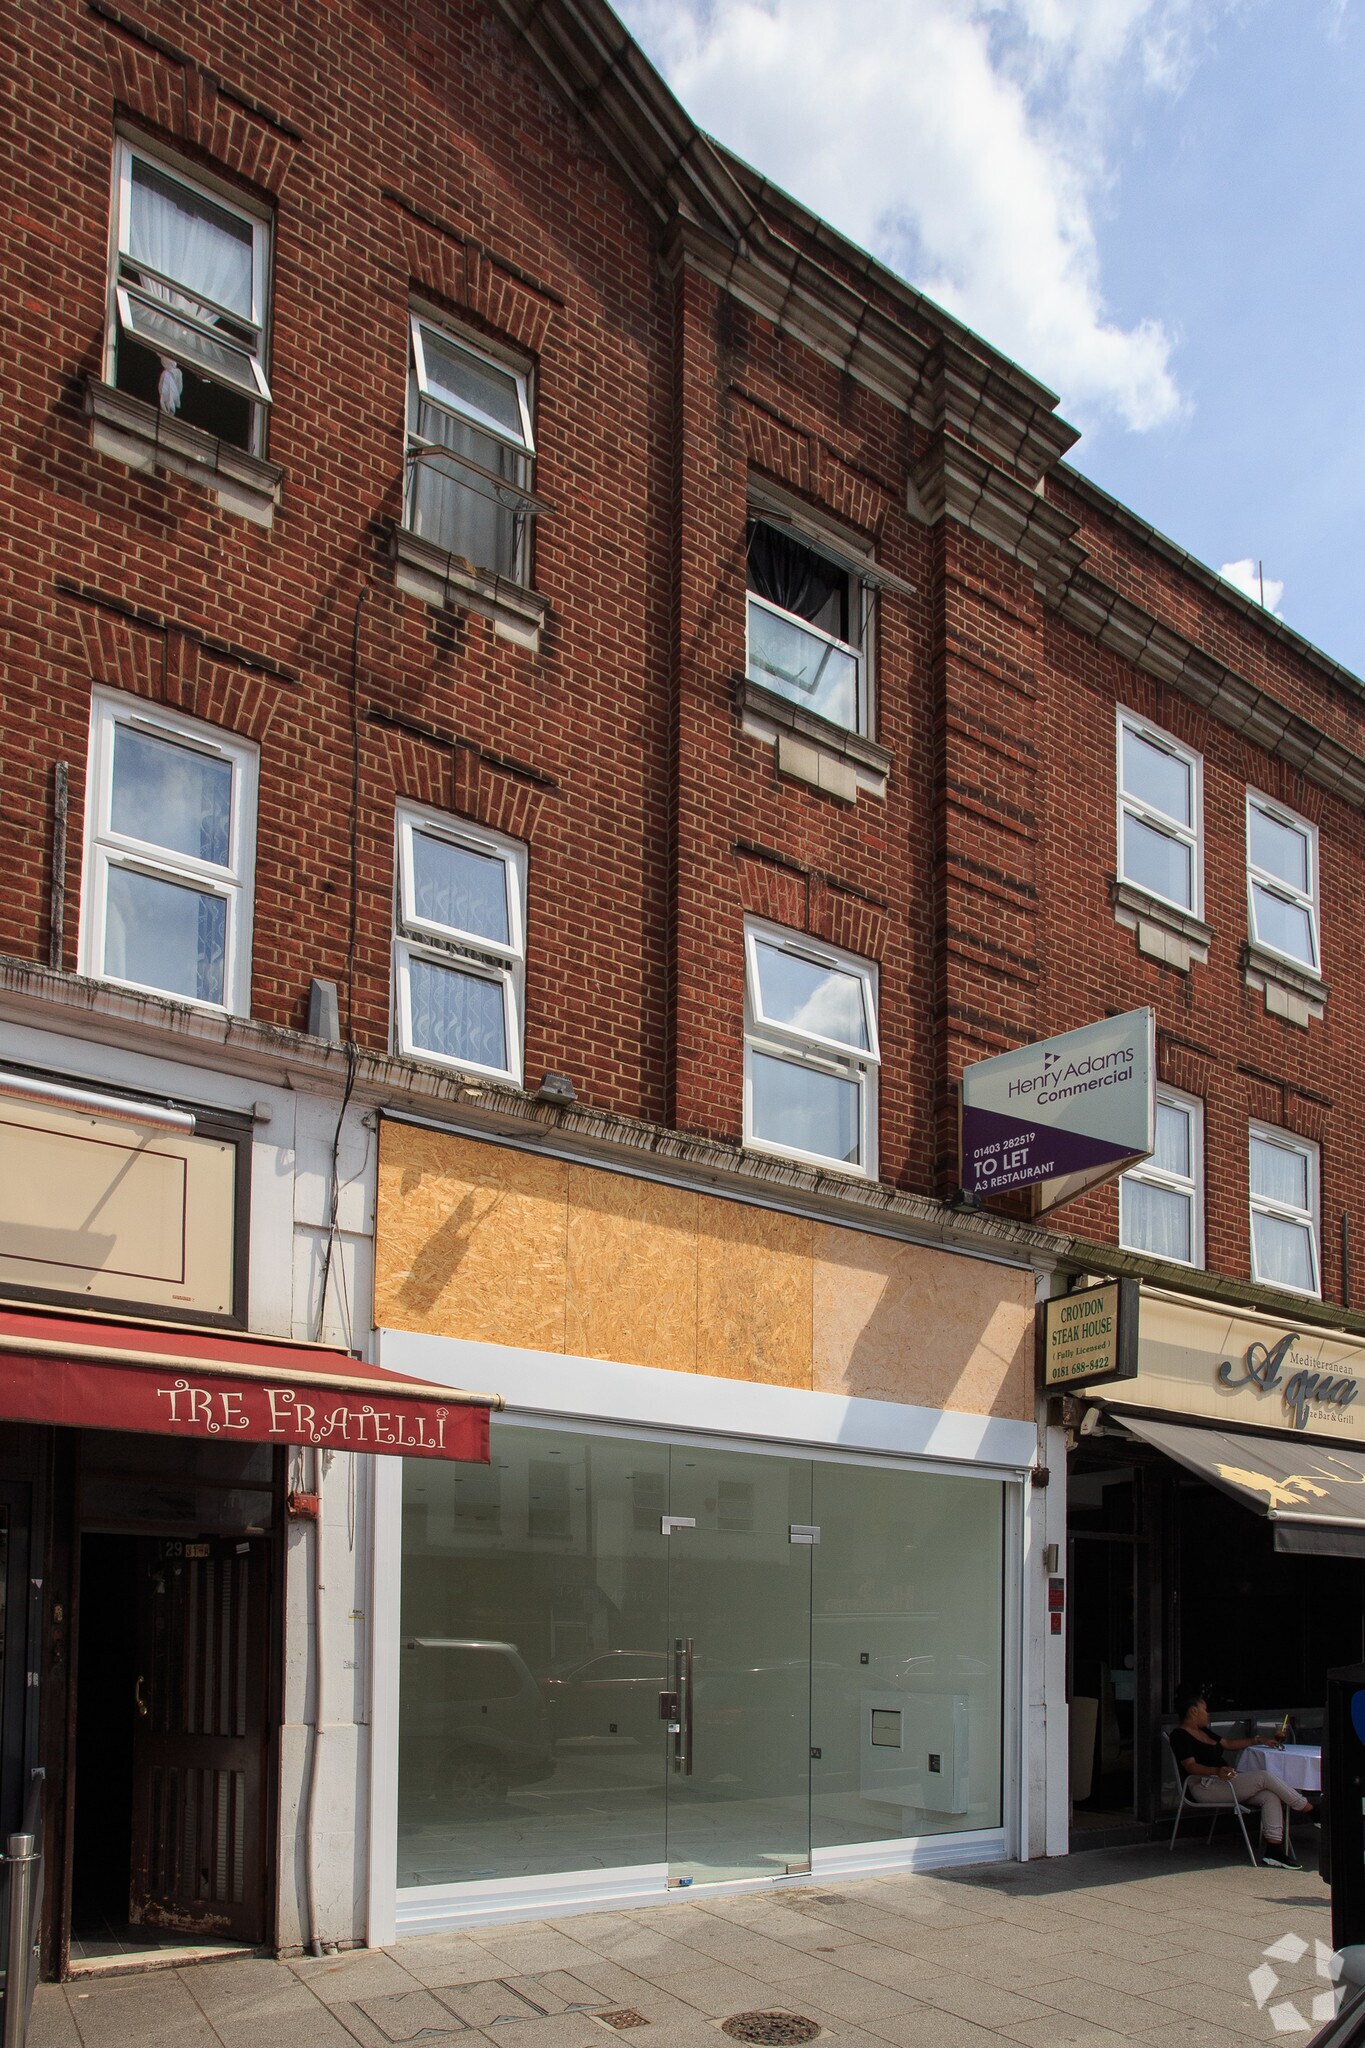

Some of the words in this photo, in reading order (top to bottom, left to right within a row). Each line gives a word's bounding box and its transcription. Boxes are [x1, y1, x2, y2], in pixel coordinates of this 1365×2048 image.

[1008, 1069, 1063, 1098] Henry
[1063, 1048, 1134, 1081] Adams
[1037, 1066, 1133, 1105] Commercial
[973, 1143, 1001, 1159] 01403
[1002, 1132, 1036, 1151] 282519
[974, 1158, 997, 1178] TO
[1003, 1148, 1029, 1171] LET
[974, 1179, 989, 1193] A3
[990, 1161, 1055, 1188] RESTAURANT
[1060, 1297, 1104, 1323] CROYDON
[1052, 1325, 1080, 1346] STEAK
[1081, 1316, 1112, 1339] HOUSE
[1052, 1366, 1069, 1379] 0181
[1071, 1356, 1109, 1375] 688-8422
[1290, 1352, 1353, 1375] Mediterranean
[1219, 1332, 1359, 1430] Aqua
[157, 1379, 249, 1433] TRE
[263, 1387, 449, 1450] FRATELLI
[1318, 1411, 1330, 1421] Bar
[1337, 1413, 1354, 1425] Grill
[165, 1541, 182, 1557] 29
